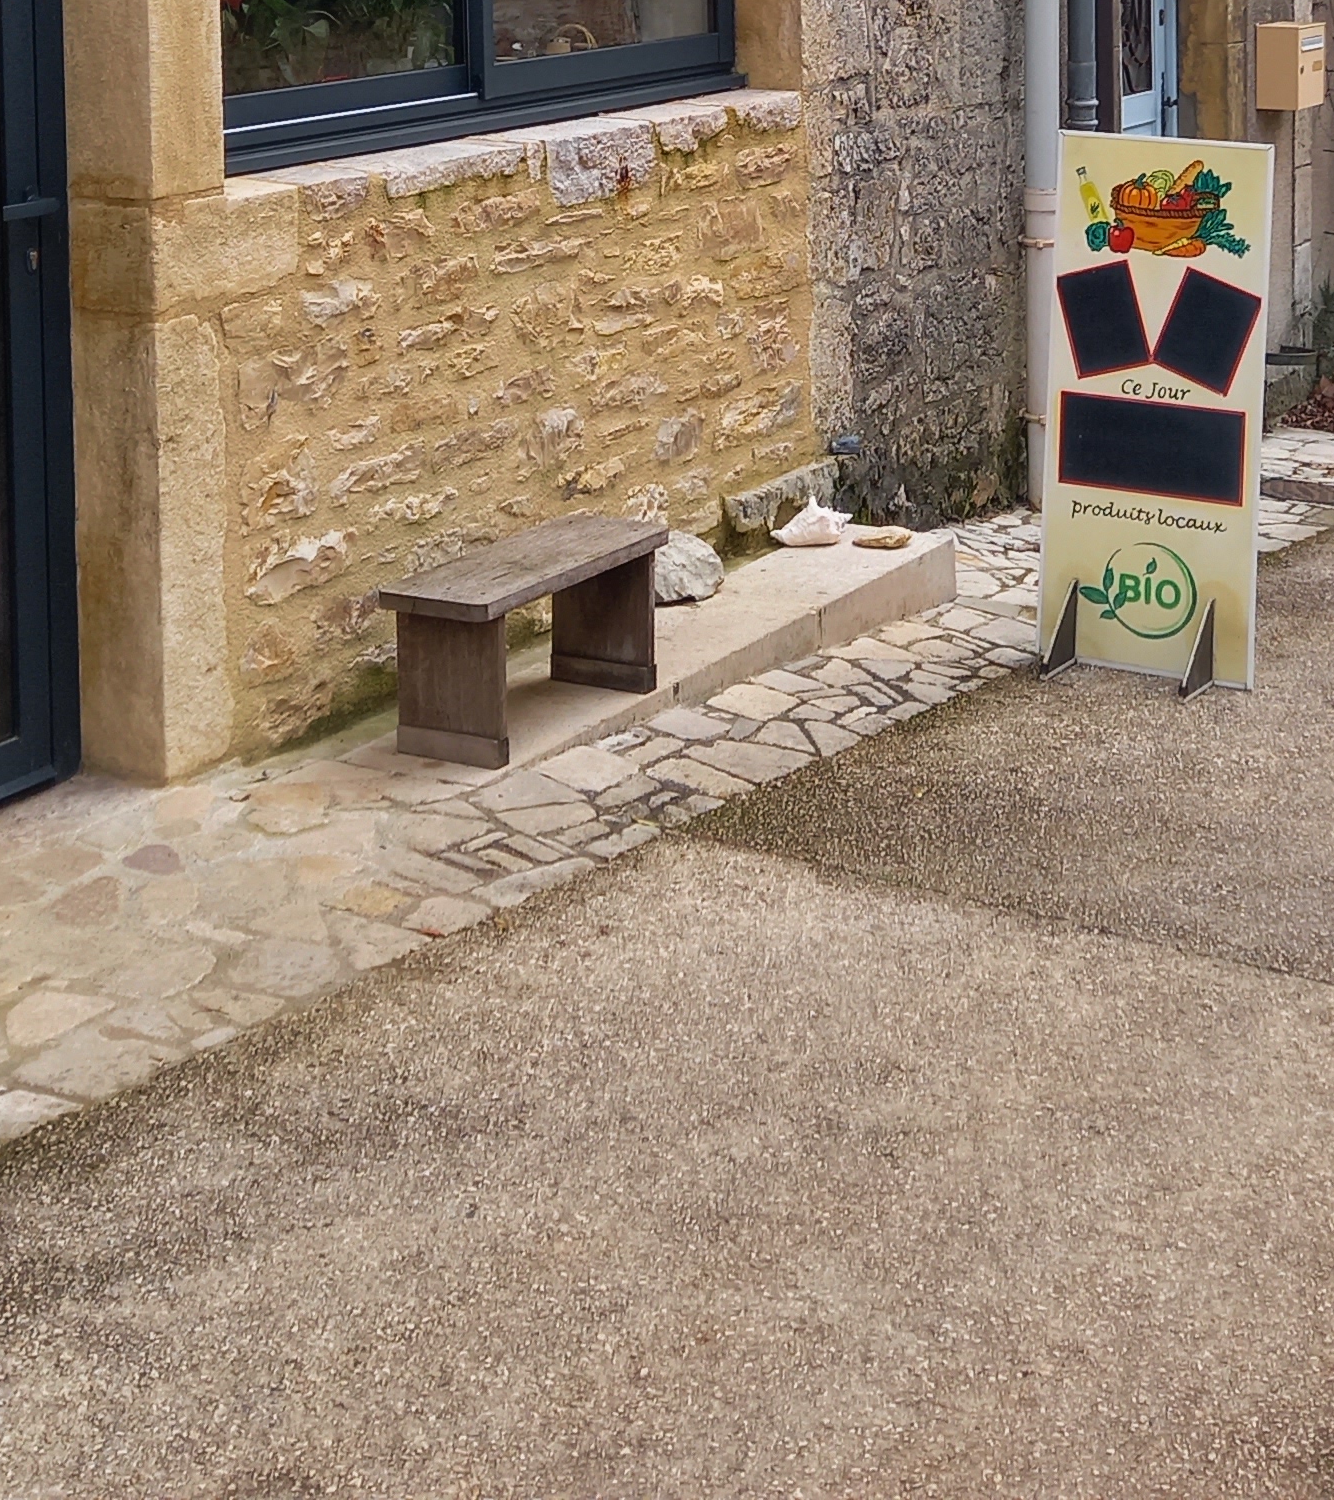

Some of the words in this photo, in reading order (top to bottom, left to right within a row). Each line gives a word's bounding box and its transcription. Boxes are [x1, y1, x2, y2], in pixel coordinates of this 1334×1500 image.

[1121, 379, 1142, 396] Ce
[1145, 382, 1190, 401] Jour
[1072, 500, 1156, 525] produits
[1157, 508, 1228, 534] locaux
